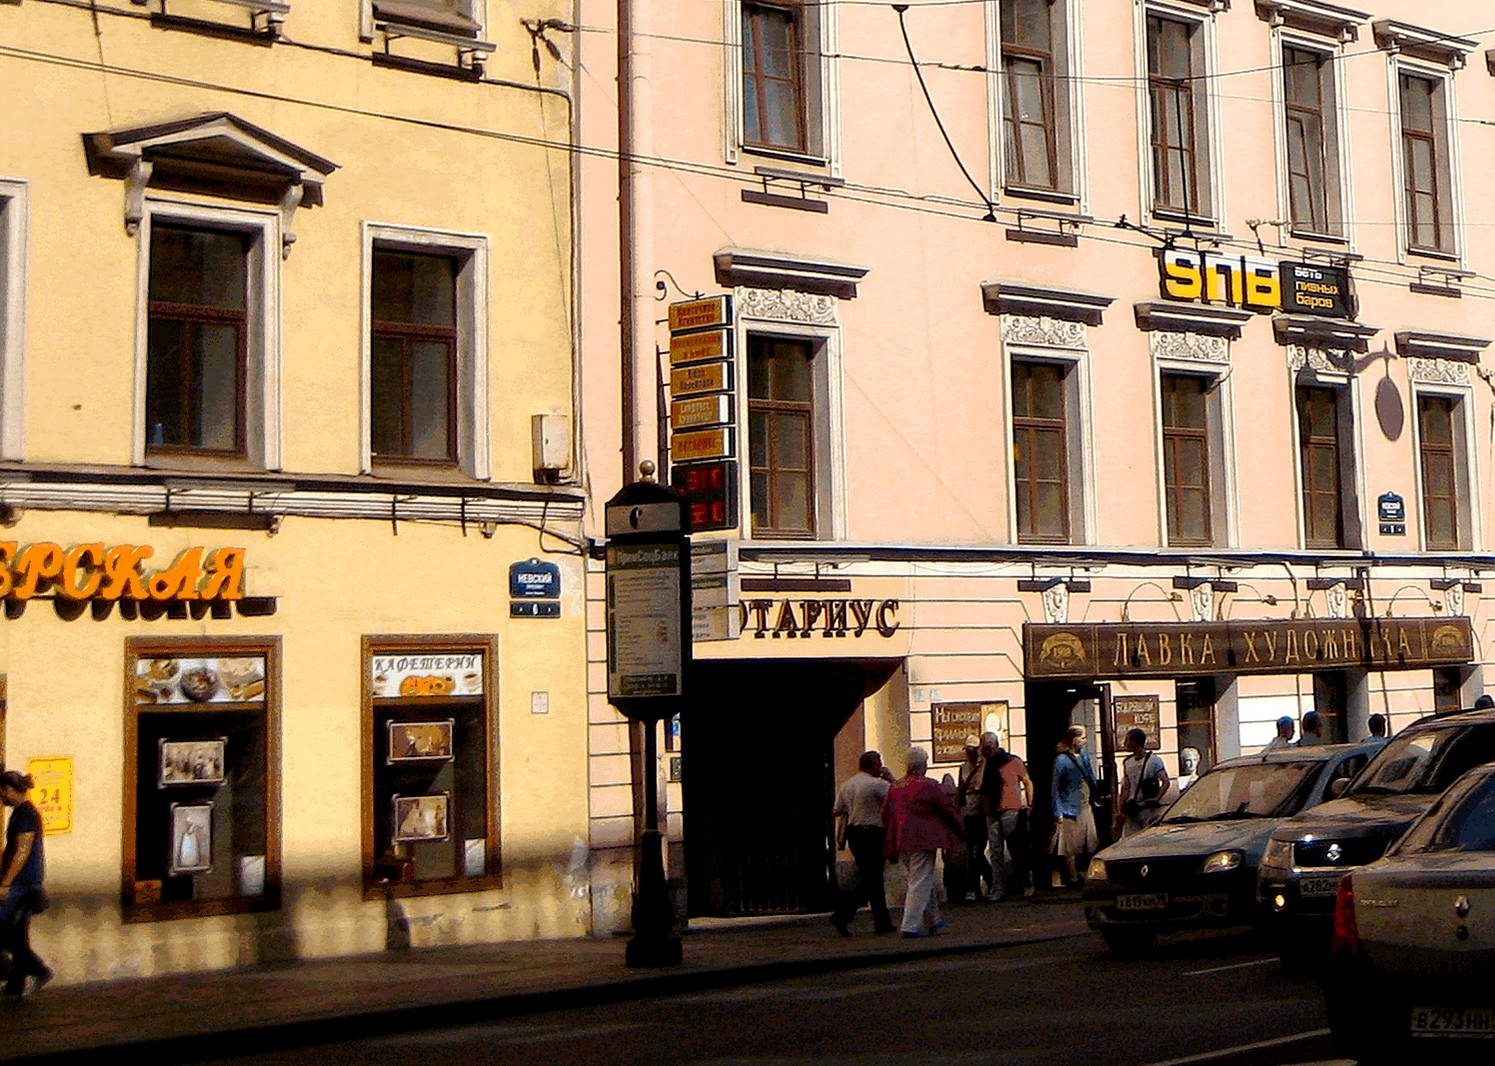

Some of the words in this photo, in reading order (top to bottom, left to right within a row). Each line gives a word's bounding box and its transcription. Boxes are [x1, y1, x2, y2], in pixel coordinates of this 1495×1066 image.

[1295, 281, 1340, 295] пивных
[1296, 292, 1334, 309] баров
[517, 571, 553, 584] НЕВСКИЙ
[1113, 632, 1217, 666] ЛАВКА
